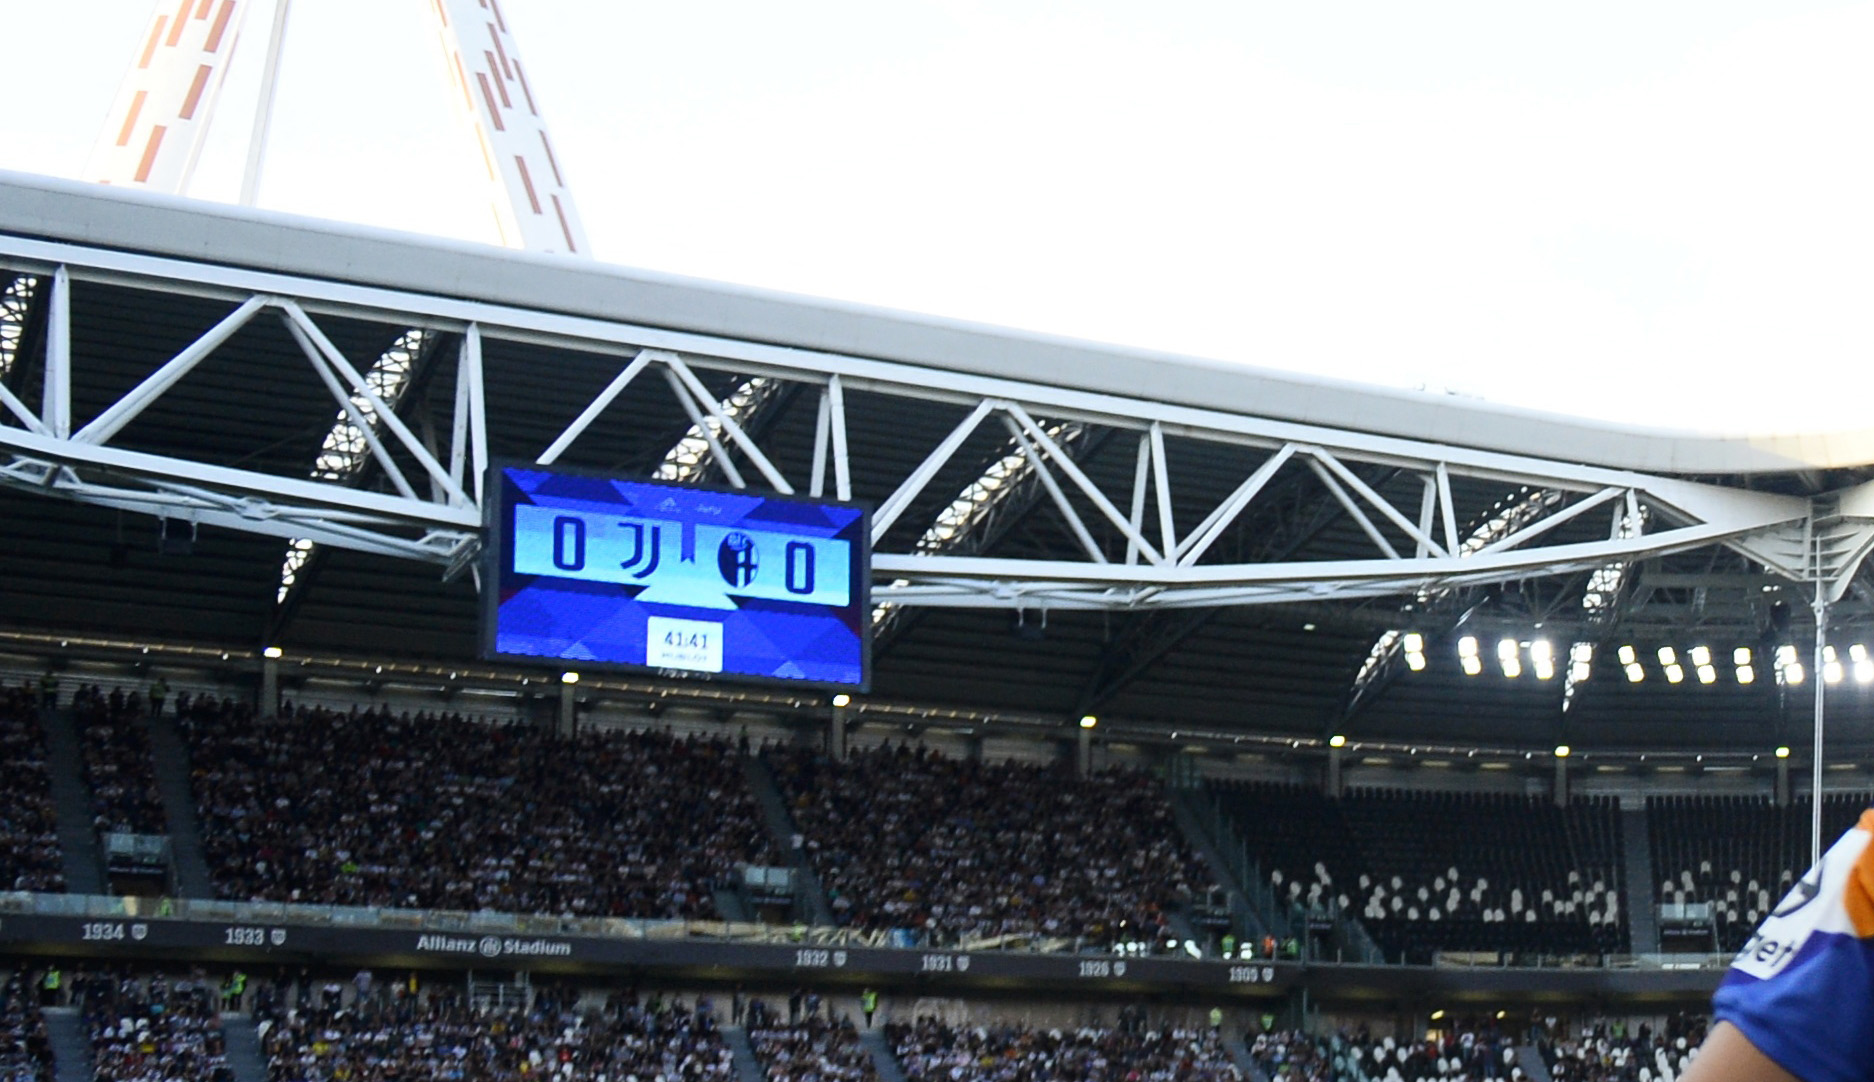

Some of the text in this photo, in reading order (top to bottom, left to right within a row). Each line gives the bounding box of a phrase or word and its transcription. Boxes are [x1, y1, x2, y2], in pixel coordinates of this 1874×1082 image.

[553, 516, 586, 571] 0
[785, 541, 815, 595] 0
[82, 923, 125, 940] 1934
[225, 928, 264, 944] 1933
[417, 934, 571, 956] Allianz Stadium
